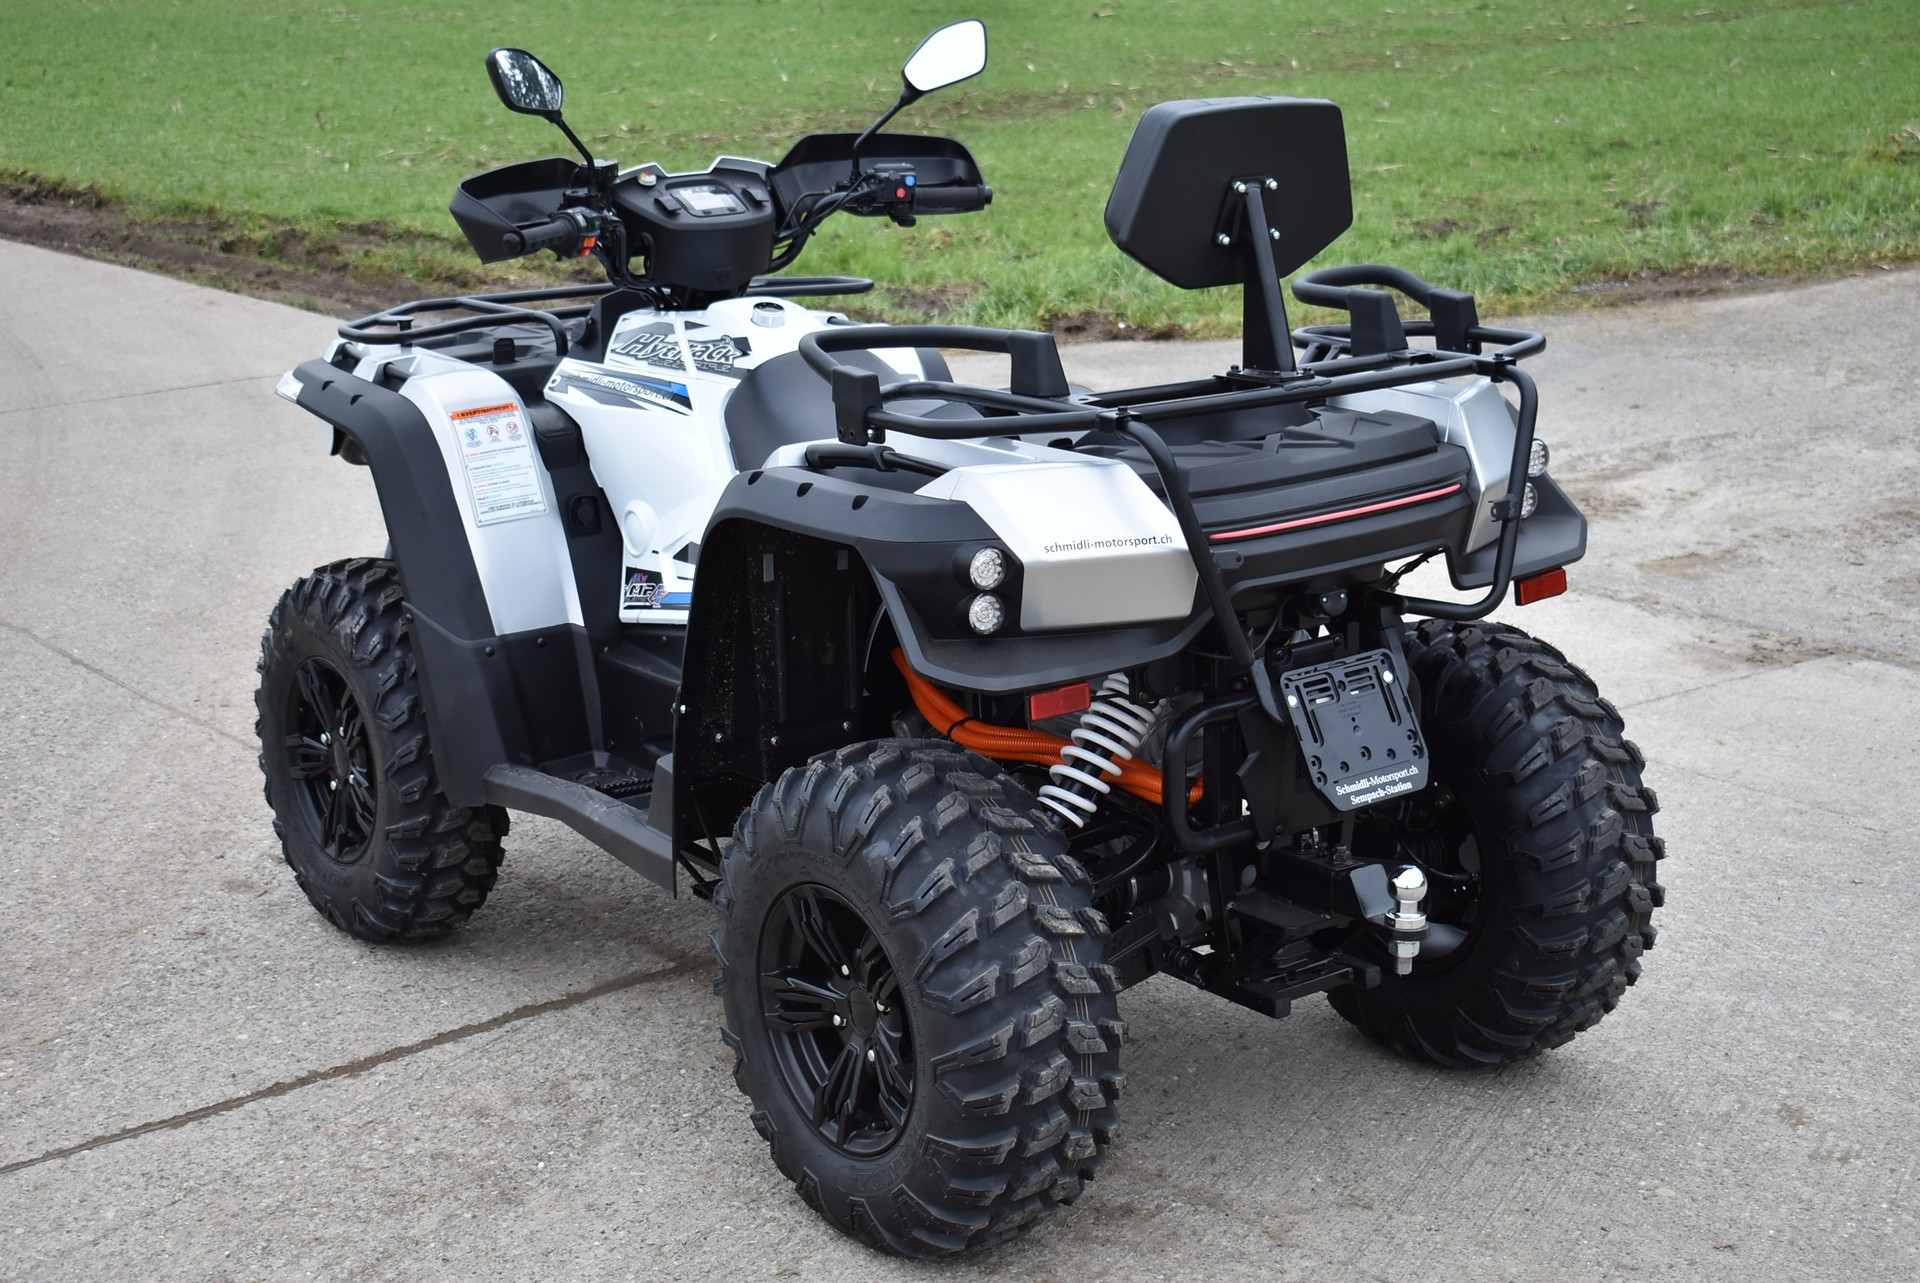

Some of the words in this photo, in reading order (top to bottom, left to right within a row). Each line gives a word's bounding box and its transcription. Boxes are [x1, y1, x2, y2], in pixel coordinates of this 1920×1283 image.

[1044, 534, 1173, 553] schmidli-motorsport.ch
[1335, 765, 1419, 796] Schmidli-Motorsport.ch
[1350, 781, 1412, 805] Sempach-Station
